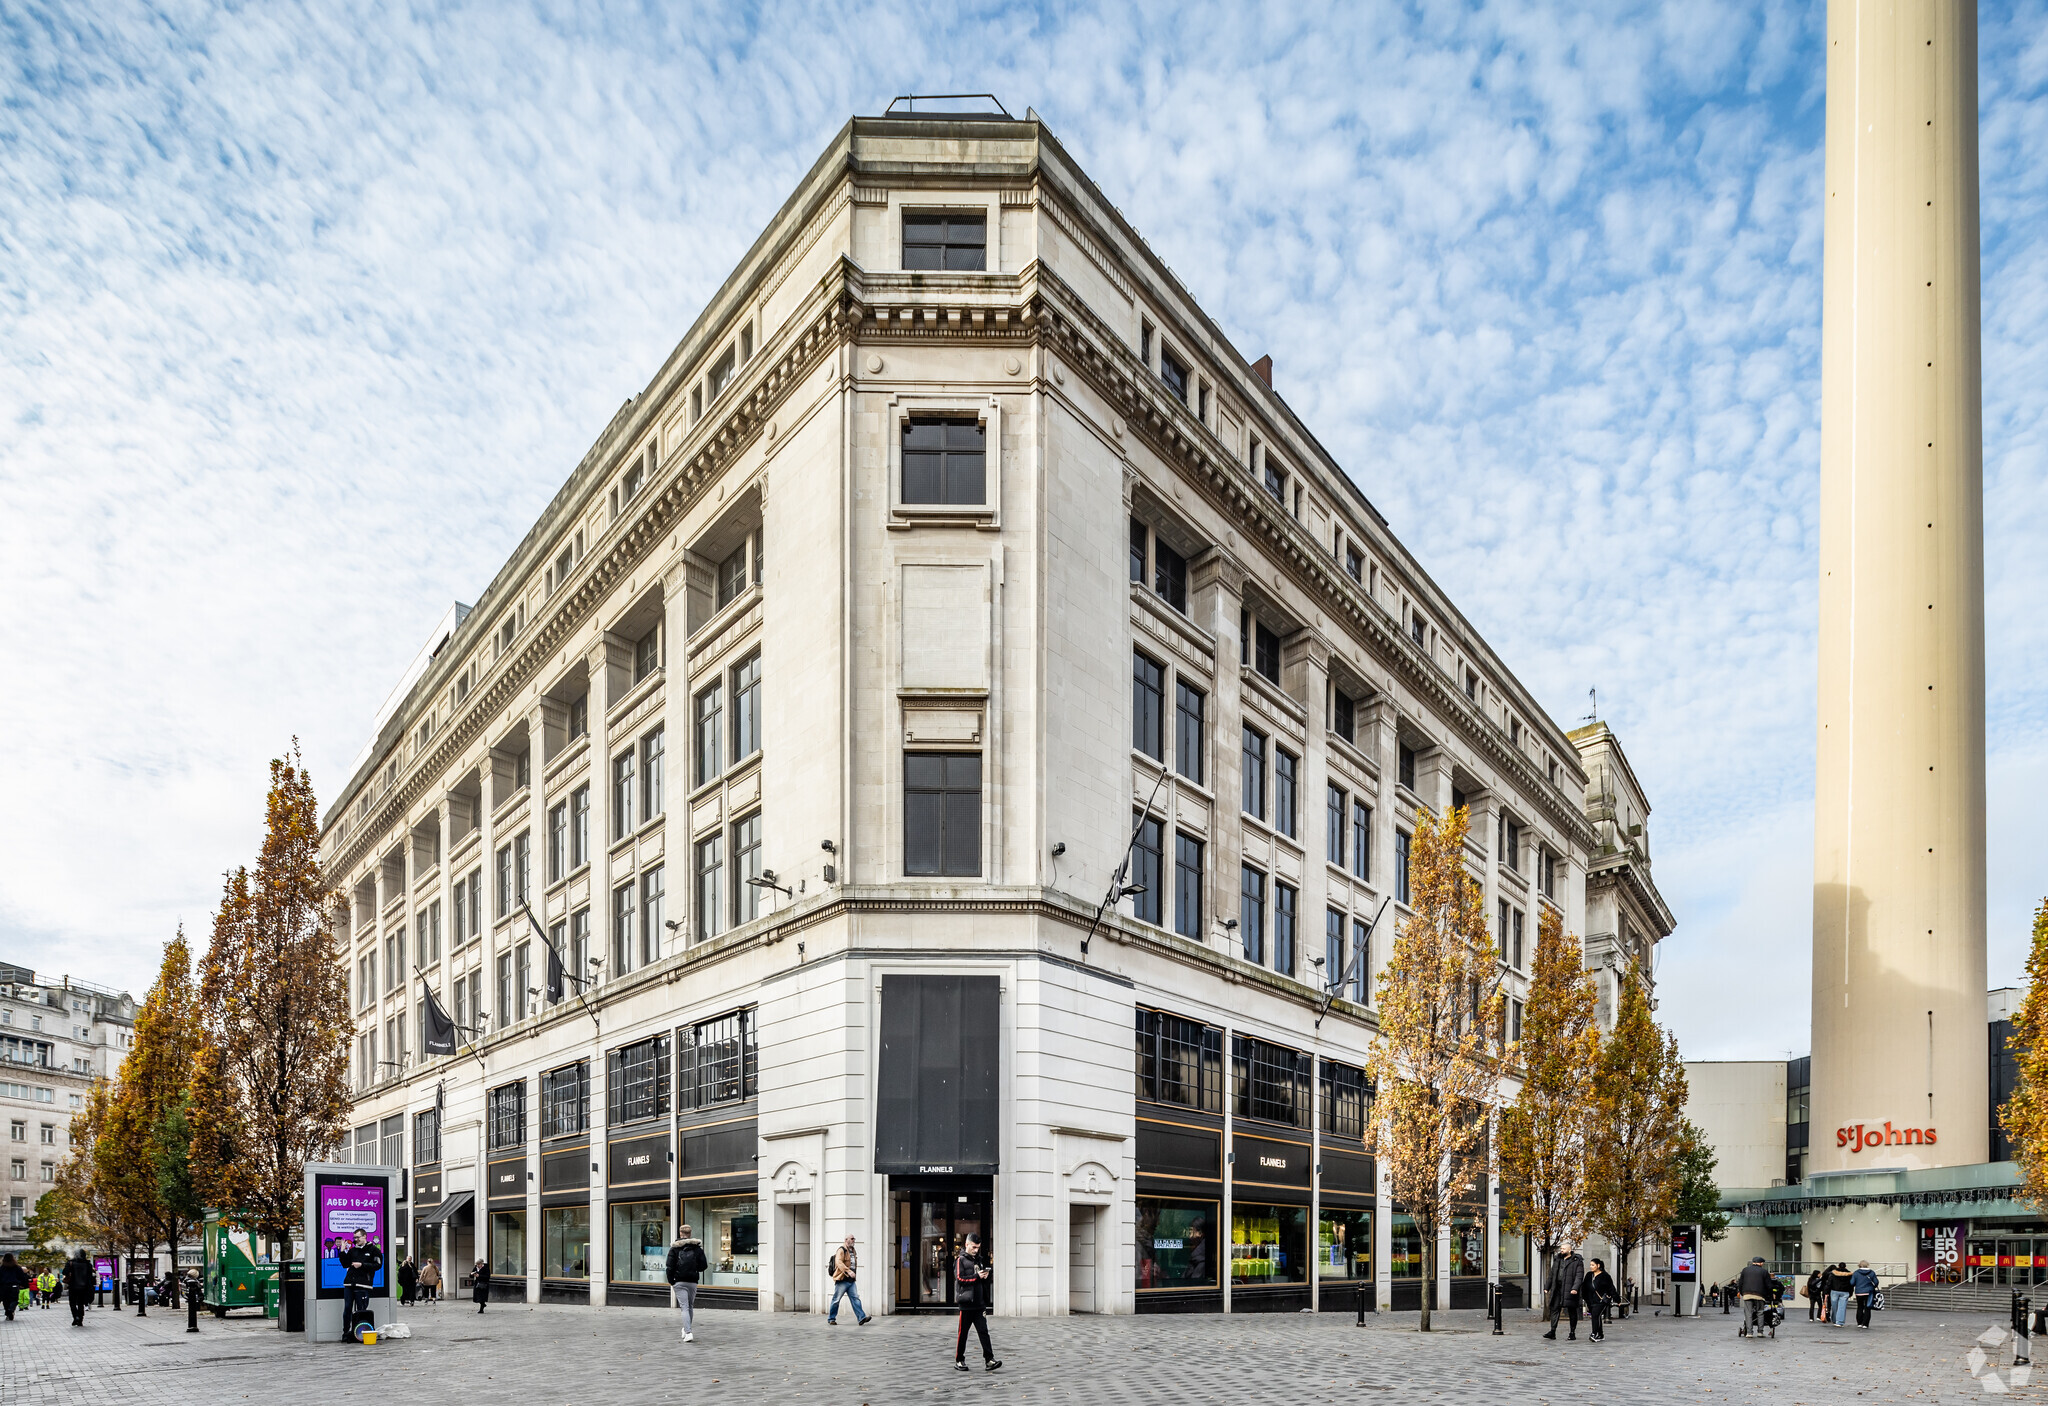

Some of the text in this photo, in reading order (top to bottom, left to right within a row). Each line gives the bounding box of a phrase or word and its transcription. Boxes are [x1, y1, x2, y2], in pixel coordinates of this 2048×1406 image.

[628, 1155, 650, 1166] FLANNELS
[1260, 1156, 1286, 1168] FLANNELS
[326, 1198, 379, 1208] AGED 16-24?
[1921, 1226, 1958, 1239] I LIV
[1934, 1238, 1957, 1250] ER
[1934, 1250, 1959, 1263] PO
